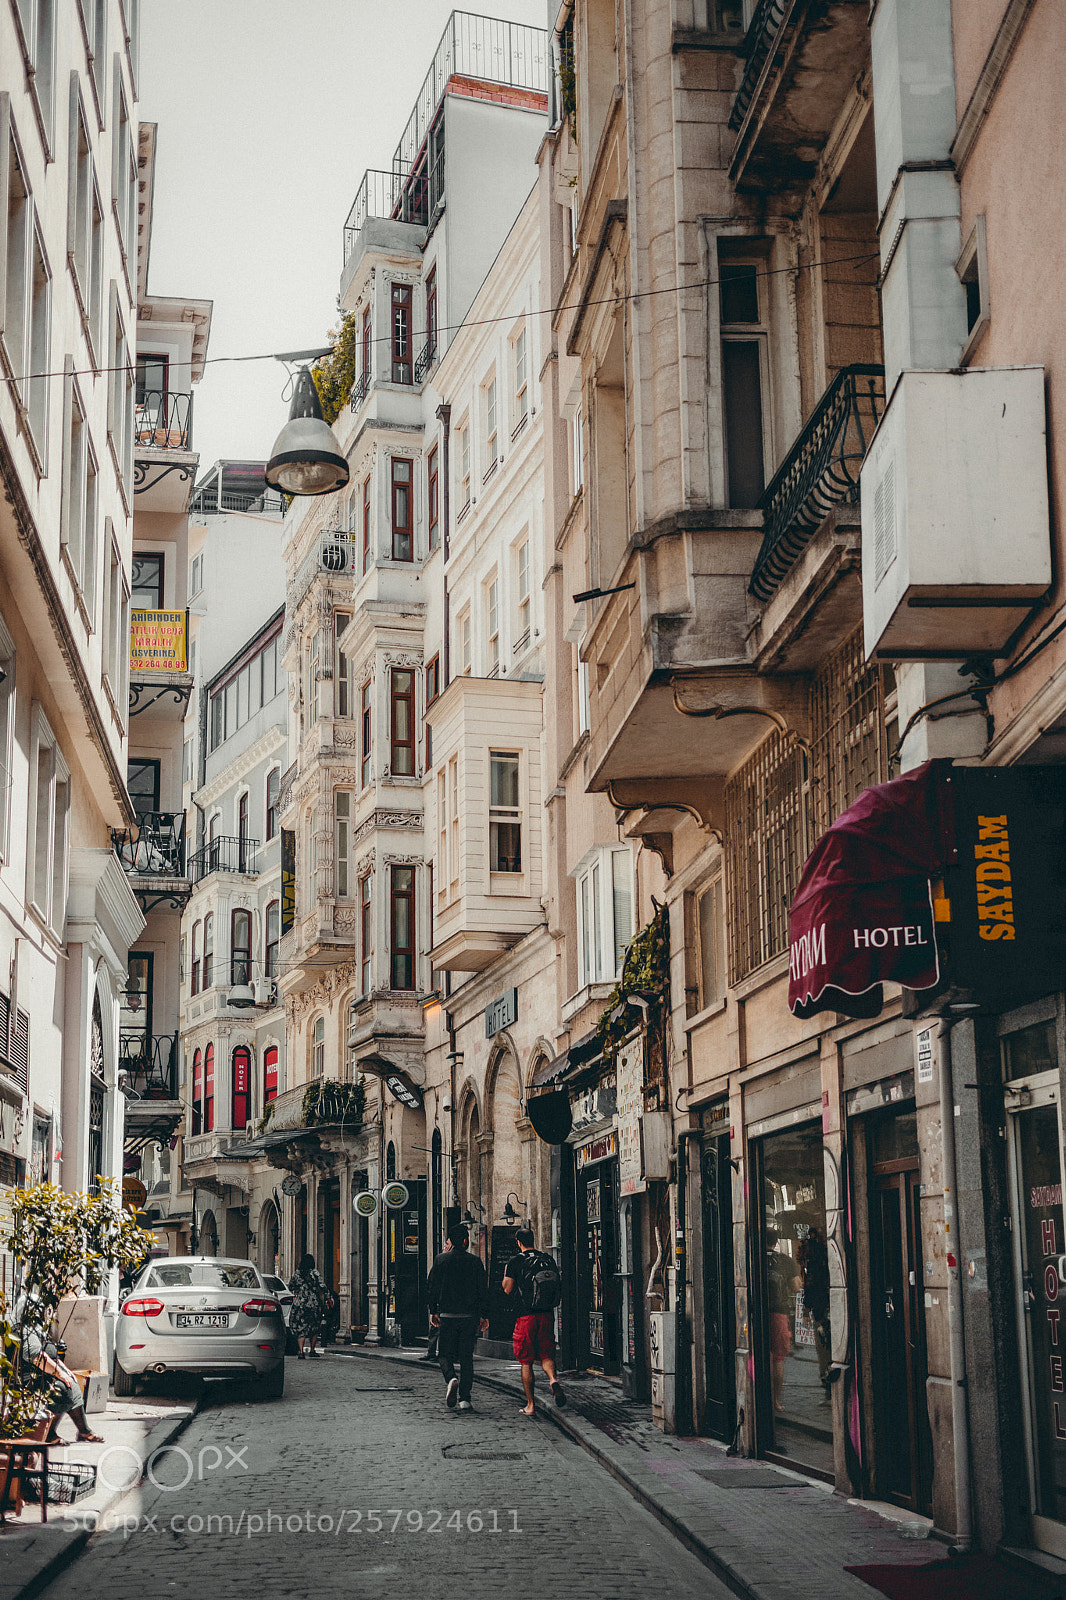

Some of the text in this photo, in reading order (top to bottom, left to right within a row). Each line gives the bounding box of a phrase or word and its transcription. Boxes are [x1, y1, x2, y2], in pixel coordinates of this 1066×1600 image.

[135, 636, 172, 647] KİRALIK
[160, 627, 184, 636] veya
[145, 660, 160, 668] 264
[162, 660, 173, 669] 48
[974, 814, 1016, 941] SAYDAM
[853, 925, 928, 948] HOTEL
[488, 1003, 511, 1034] HOTEL
[1030, 1184, 1063, 1208] SAYDAM
[181, 1315, 227, 1325] 34 RZ 1219
[1041, 1219, 1066, 1440] HOTEL
